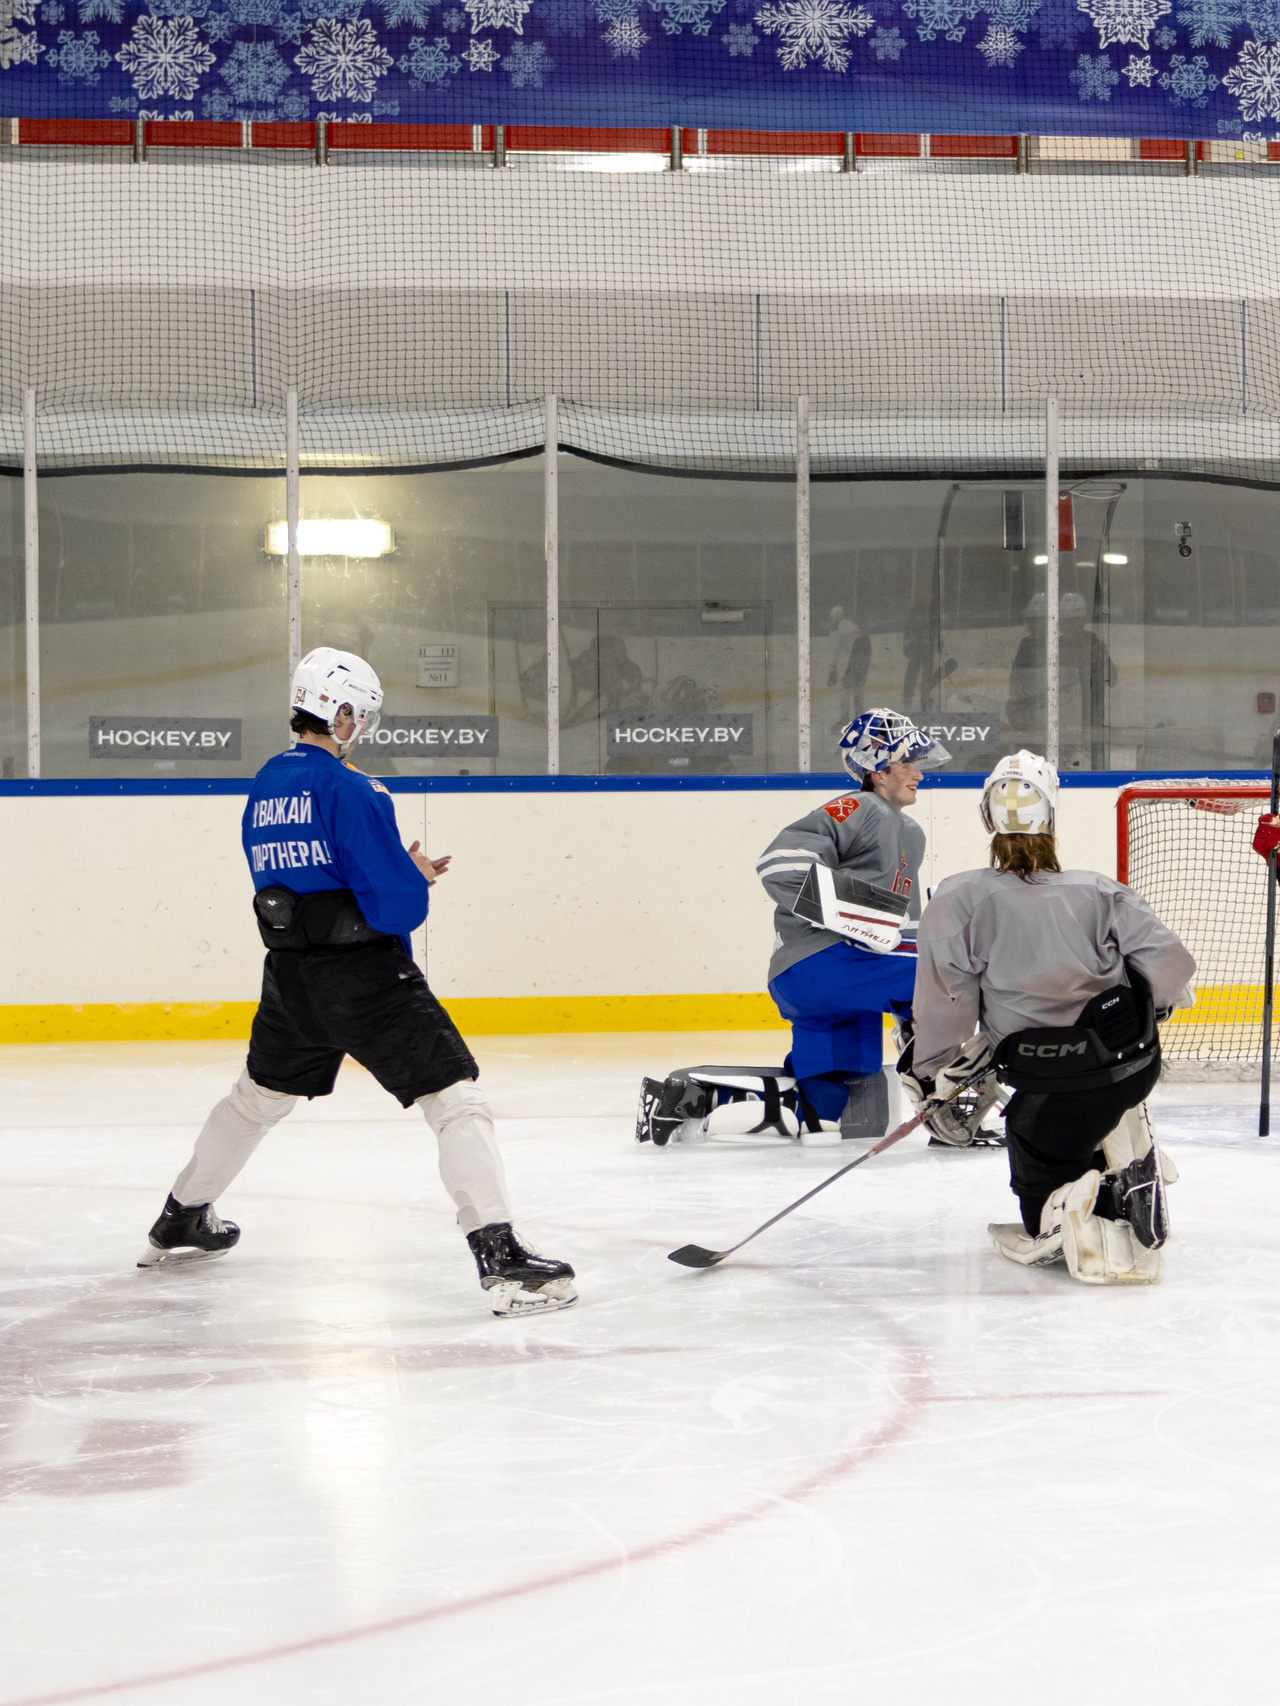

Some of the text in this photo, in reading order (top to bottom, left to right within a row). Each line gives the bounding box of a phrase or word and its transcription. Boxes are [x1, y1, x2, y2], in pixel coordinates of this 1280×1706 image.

[98, 730, 232, 747] HOCKEY.BY
[358, 729, 490, 744] HOCKEY.BY
[615, 727, 744, 743] HOCKEY.BY
[253, 791, 312, 829] УВАЖАЙ
[251, 840, 333, 873] ПАРТНЕРА!
[1101, 997, 1120, 1010] CCM
[1018, 1041, 1087, 1058] CCM
[1028, 1247, 1064, 1267] TRUE
